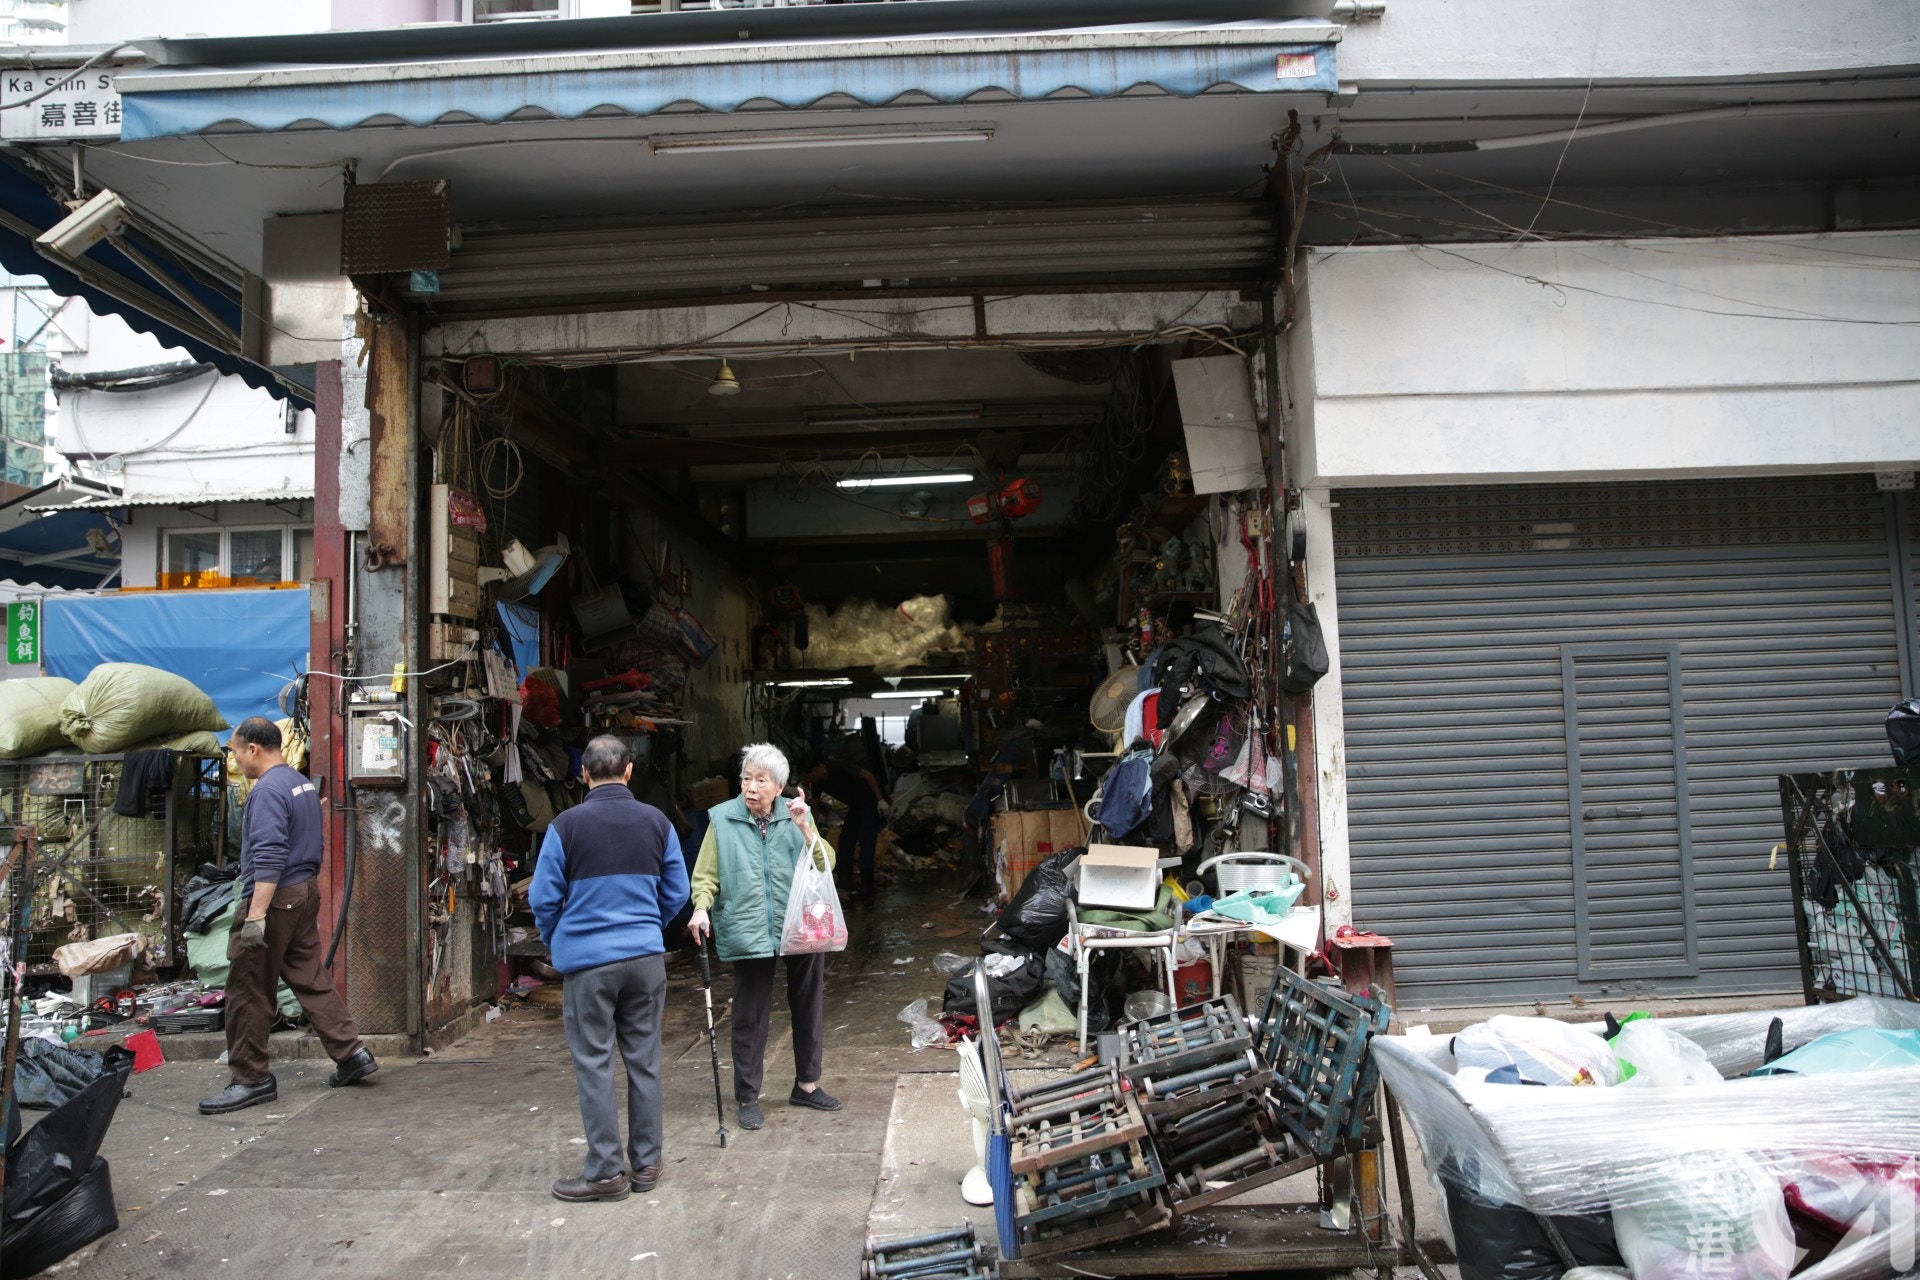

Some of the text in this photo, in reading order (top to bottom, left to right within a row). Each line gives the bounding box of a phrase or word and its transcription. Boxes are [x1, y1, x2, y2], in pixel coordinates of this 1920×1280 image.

[9, 78, 33, 92] Ka
[97, 75, 117, 90] S
[16, 603, 35, 661] 釣魚餌
